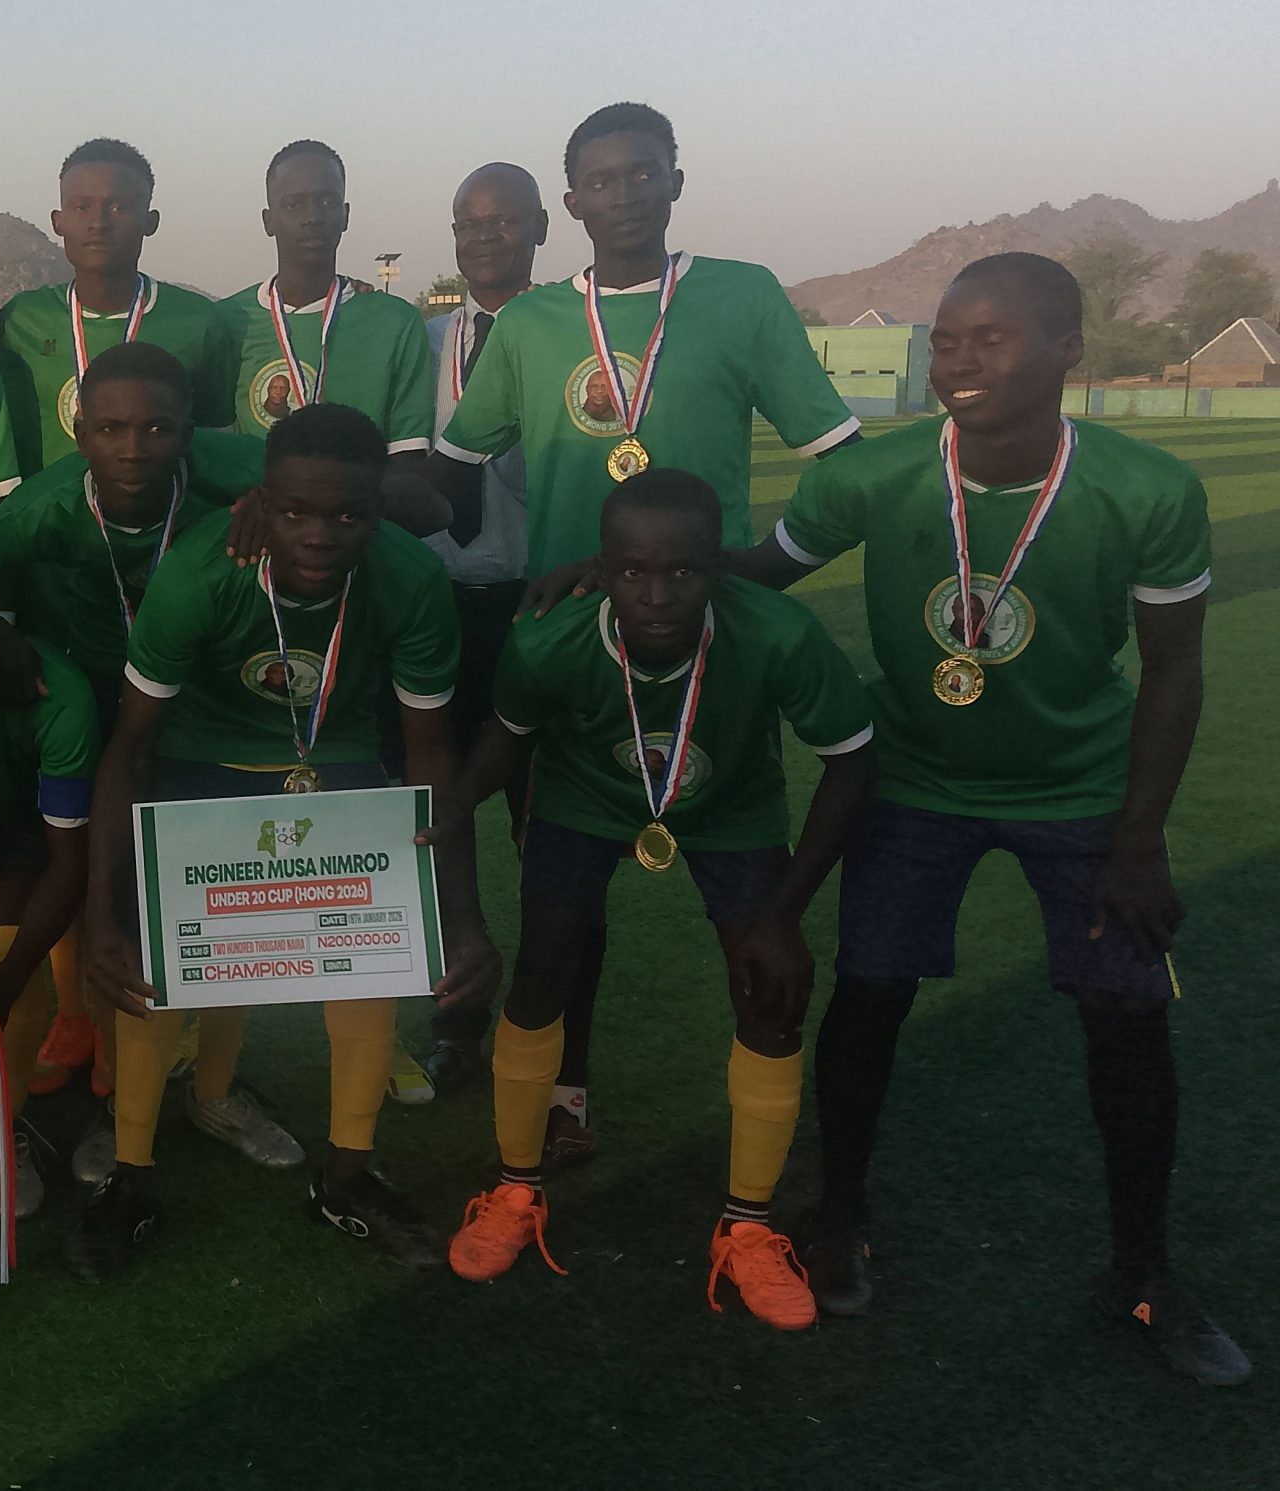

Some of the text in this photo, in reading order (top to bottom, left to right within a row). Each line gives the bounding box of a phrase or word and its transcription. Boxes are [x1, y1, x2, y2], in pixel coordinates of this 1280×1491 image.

[185, 852, 389, 884] ENGINEER MUSA NIMROD
[210, 882, 368, 908] UNDER 20 CUP (HONG 2026)
[180, 925, 198, 934] PAY
[321, 916, 346, 926] DATE
[212, 938, 305, 956] TWO HUNDRED THOUSAND NAIRA
[204, 960, 314, 981] CHAMPIONS
